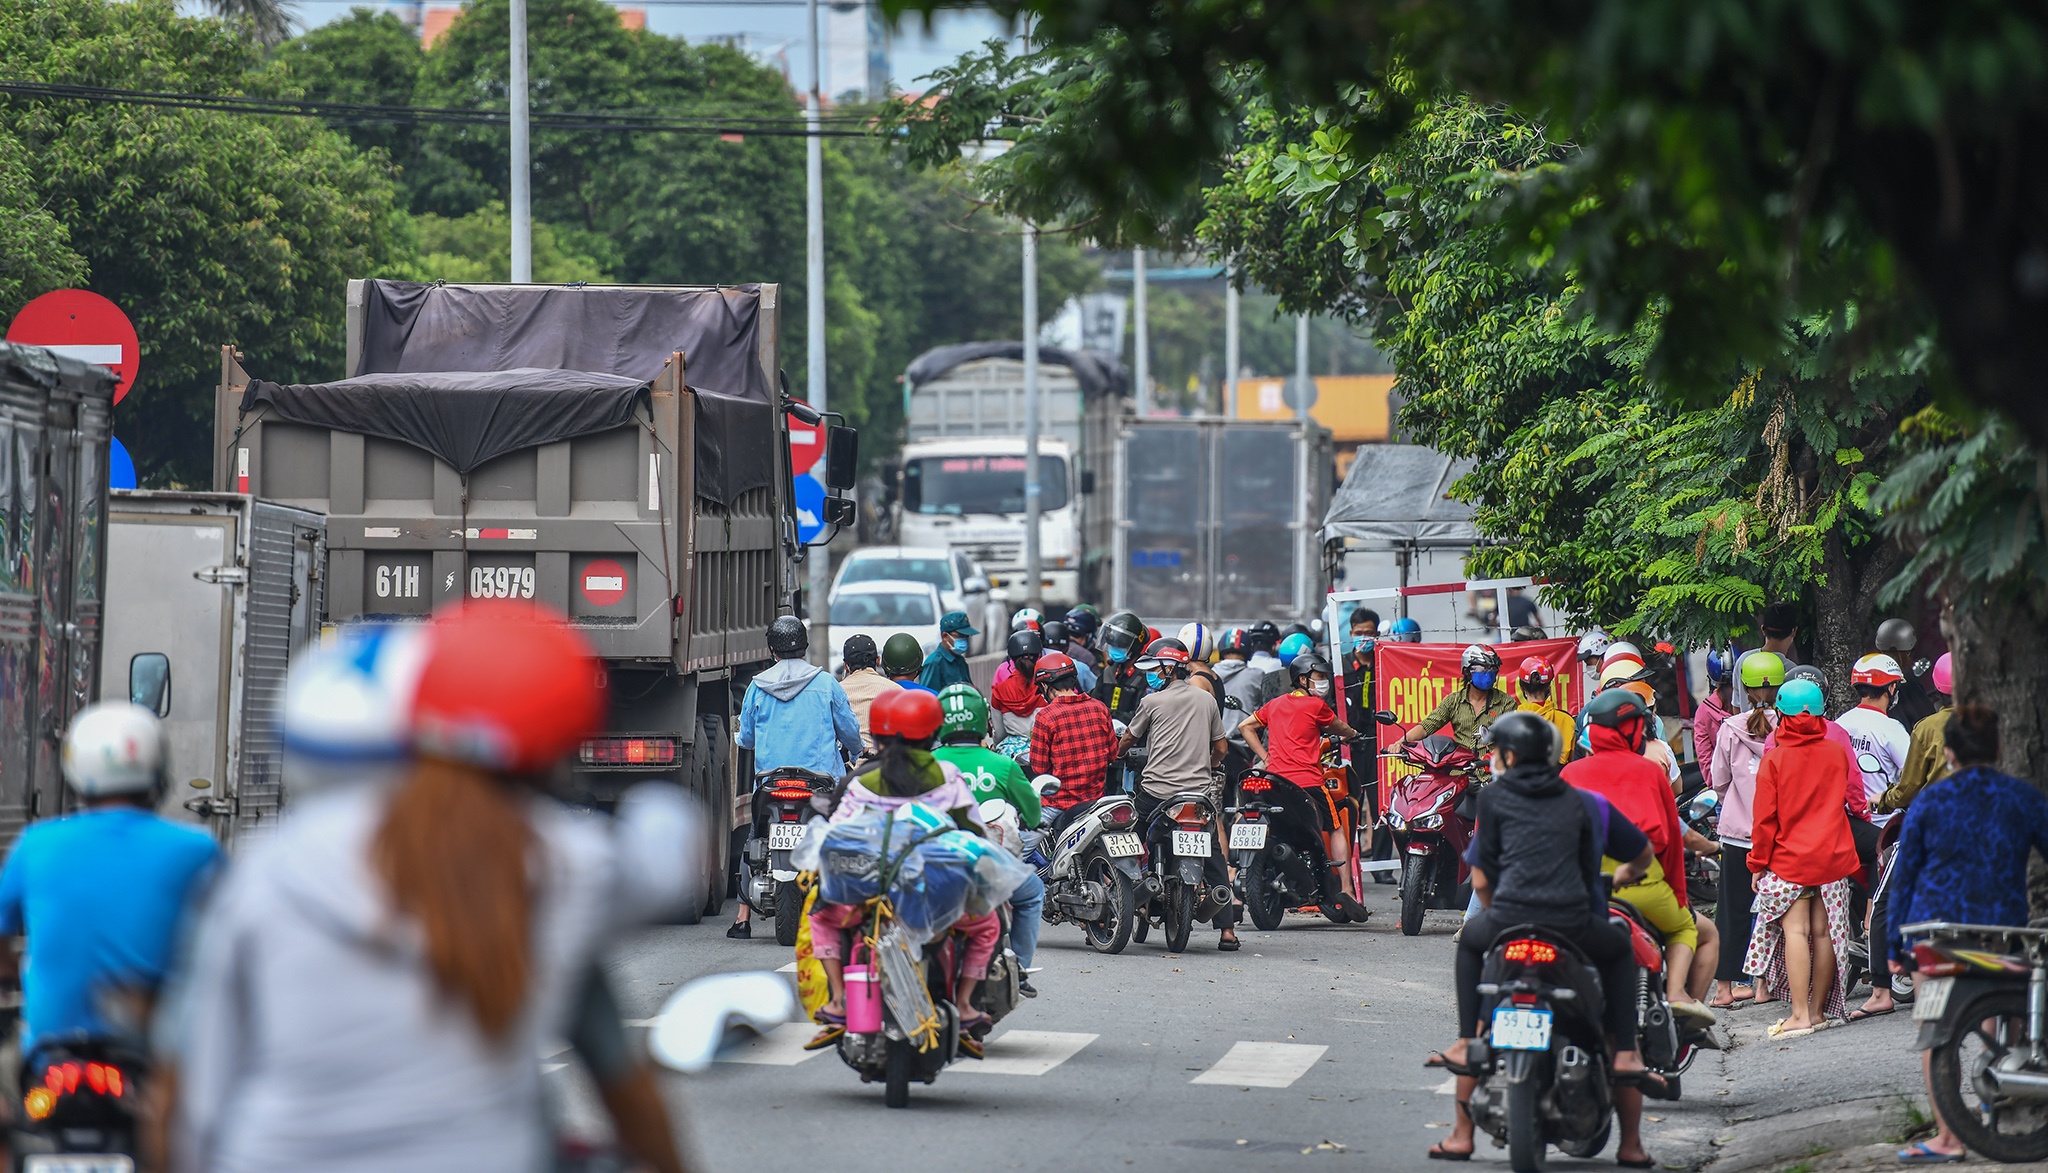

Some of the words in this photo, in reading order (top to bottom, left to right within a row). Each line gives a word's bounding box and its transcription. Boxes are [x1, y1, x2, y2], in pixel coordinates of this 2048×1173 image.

[376, 565, 419, 598] 61H
[470, 566, 536, 599] 03979
[1389, 661, 1445, 724] CHỐT
[944, 709, 974, 724] Grab
[961, 765, 996, 792] ab
[776, 825, 803, 837] 61-C2
[771, 837, 803, 848] 099.
[1067, 827, 1086, 849] GP
[1108, 834, 1135, 846] 37-L1
[1110, 844, 1140, 855] 611.07
[1179, 844, 1206, 855] 5321
